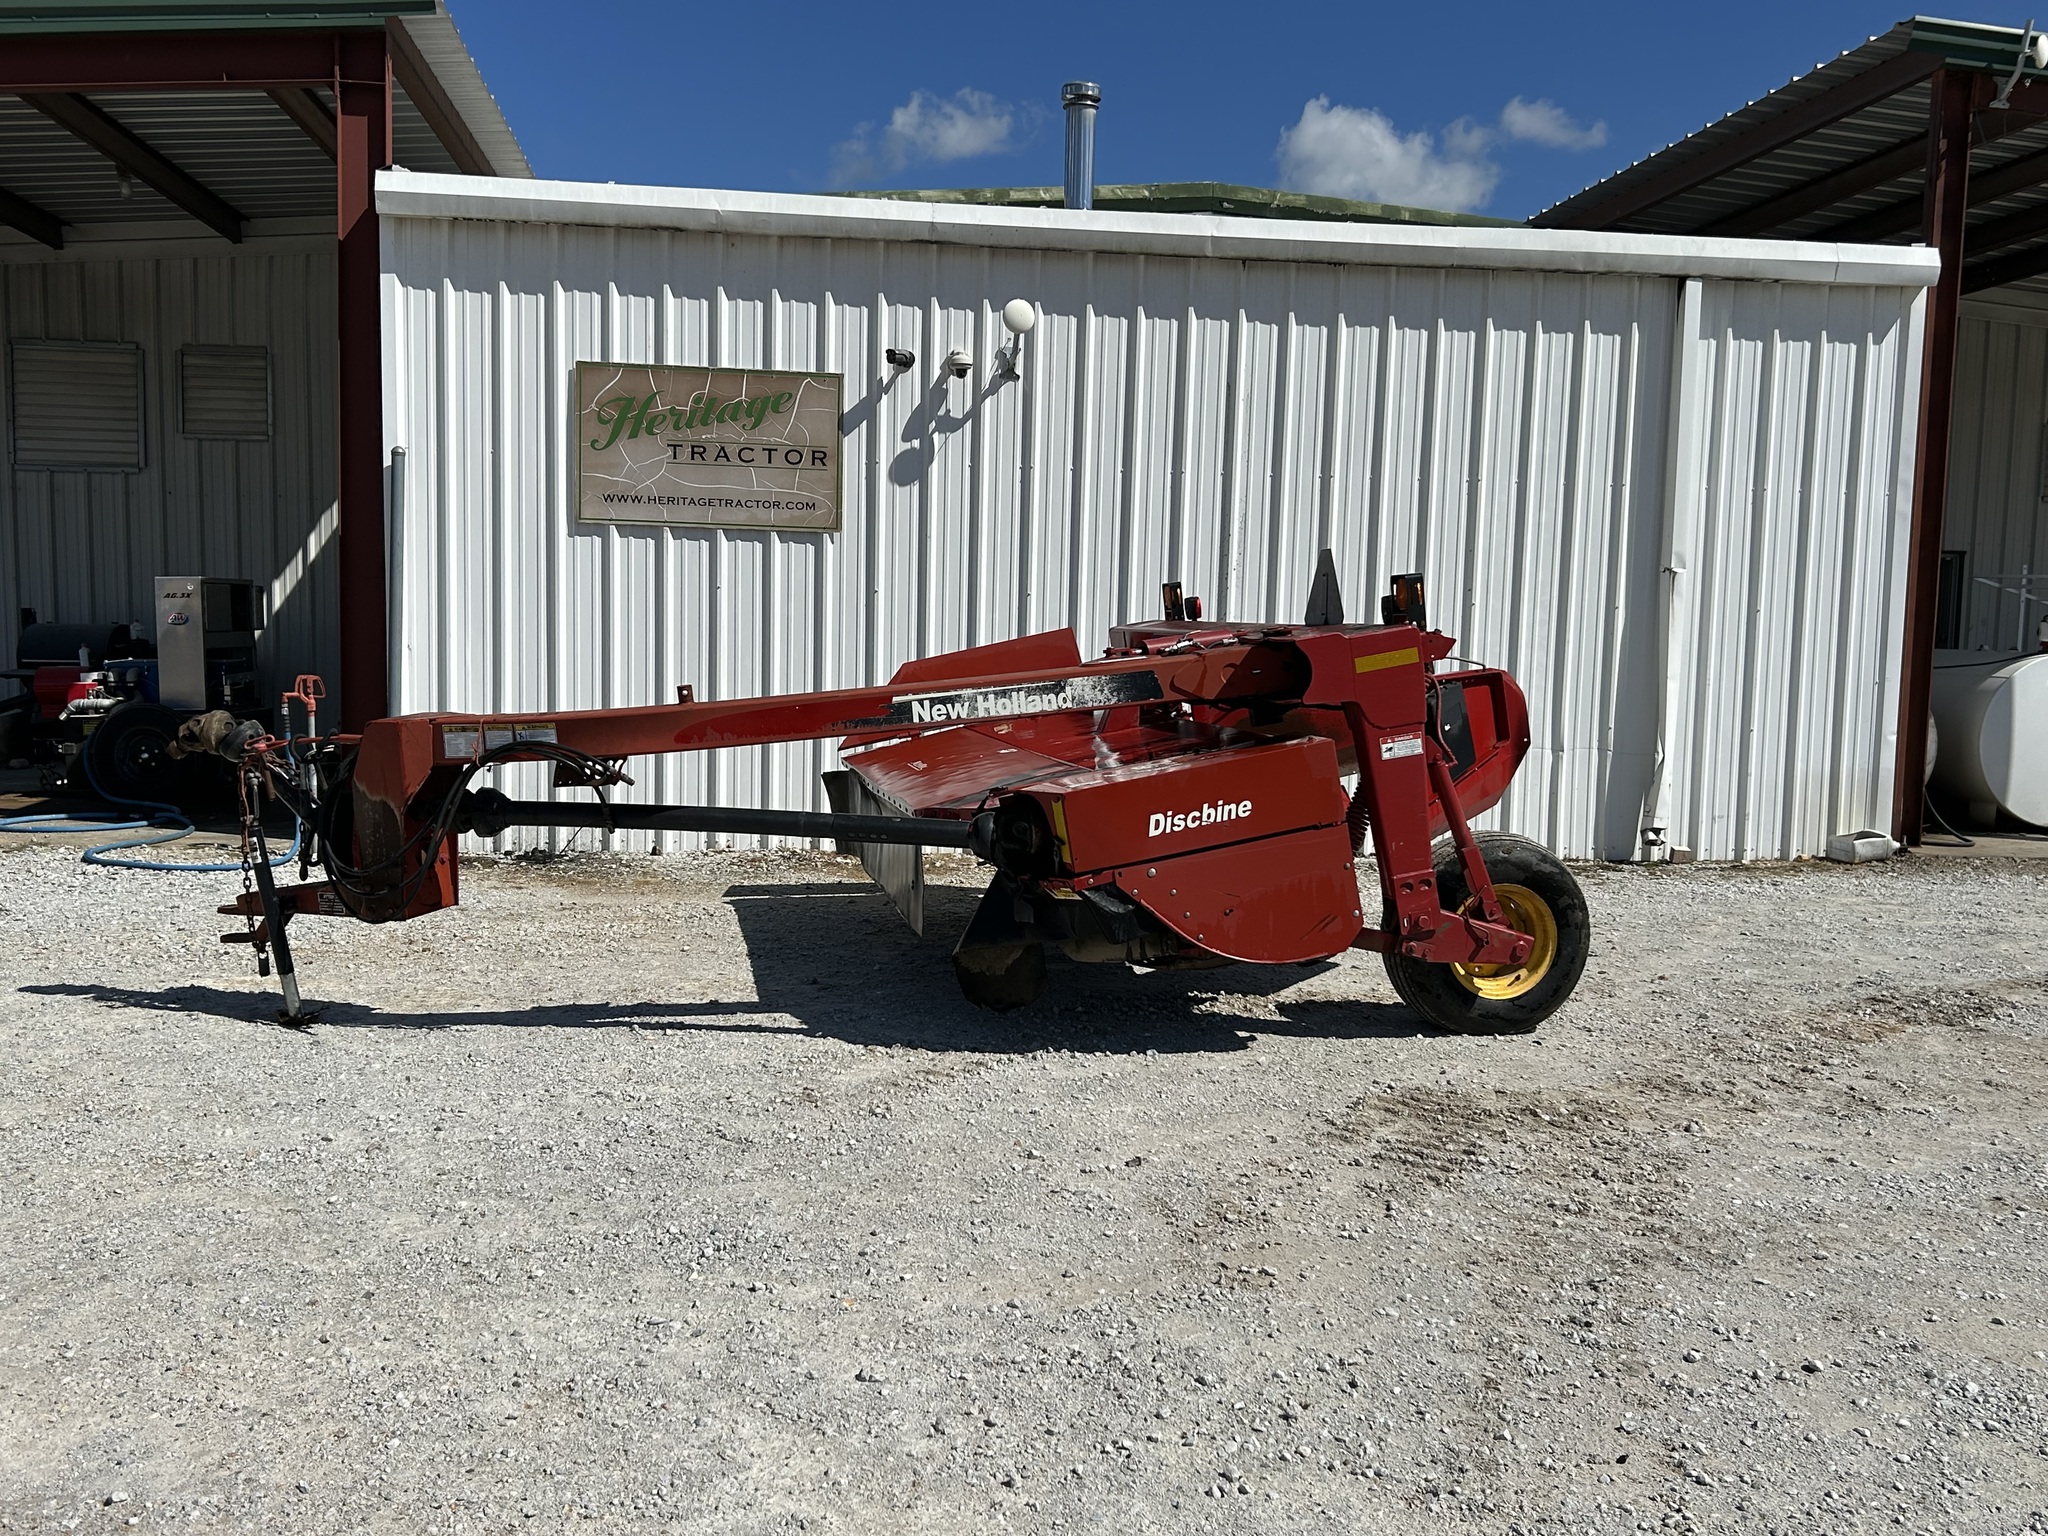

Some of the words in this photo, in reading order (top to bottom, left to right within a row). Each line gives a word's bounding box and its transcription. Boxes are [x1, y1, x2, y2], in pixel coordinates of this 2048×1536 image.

[590, 390, 793, 451] Heritage
[667, 443, 828, 467] TRACTOR
[602, 493, 816, 511] WWW.HERITAGETRACTOR.COM
[911, 699, 970, 723] New
[977, 687, 1072, 717] Holland
[1148, 800, 1253, 837] Discbine
